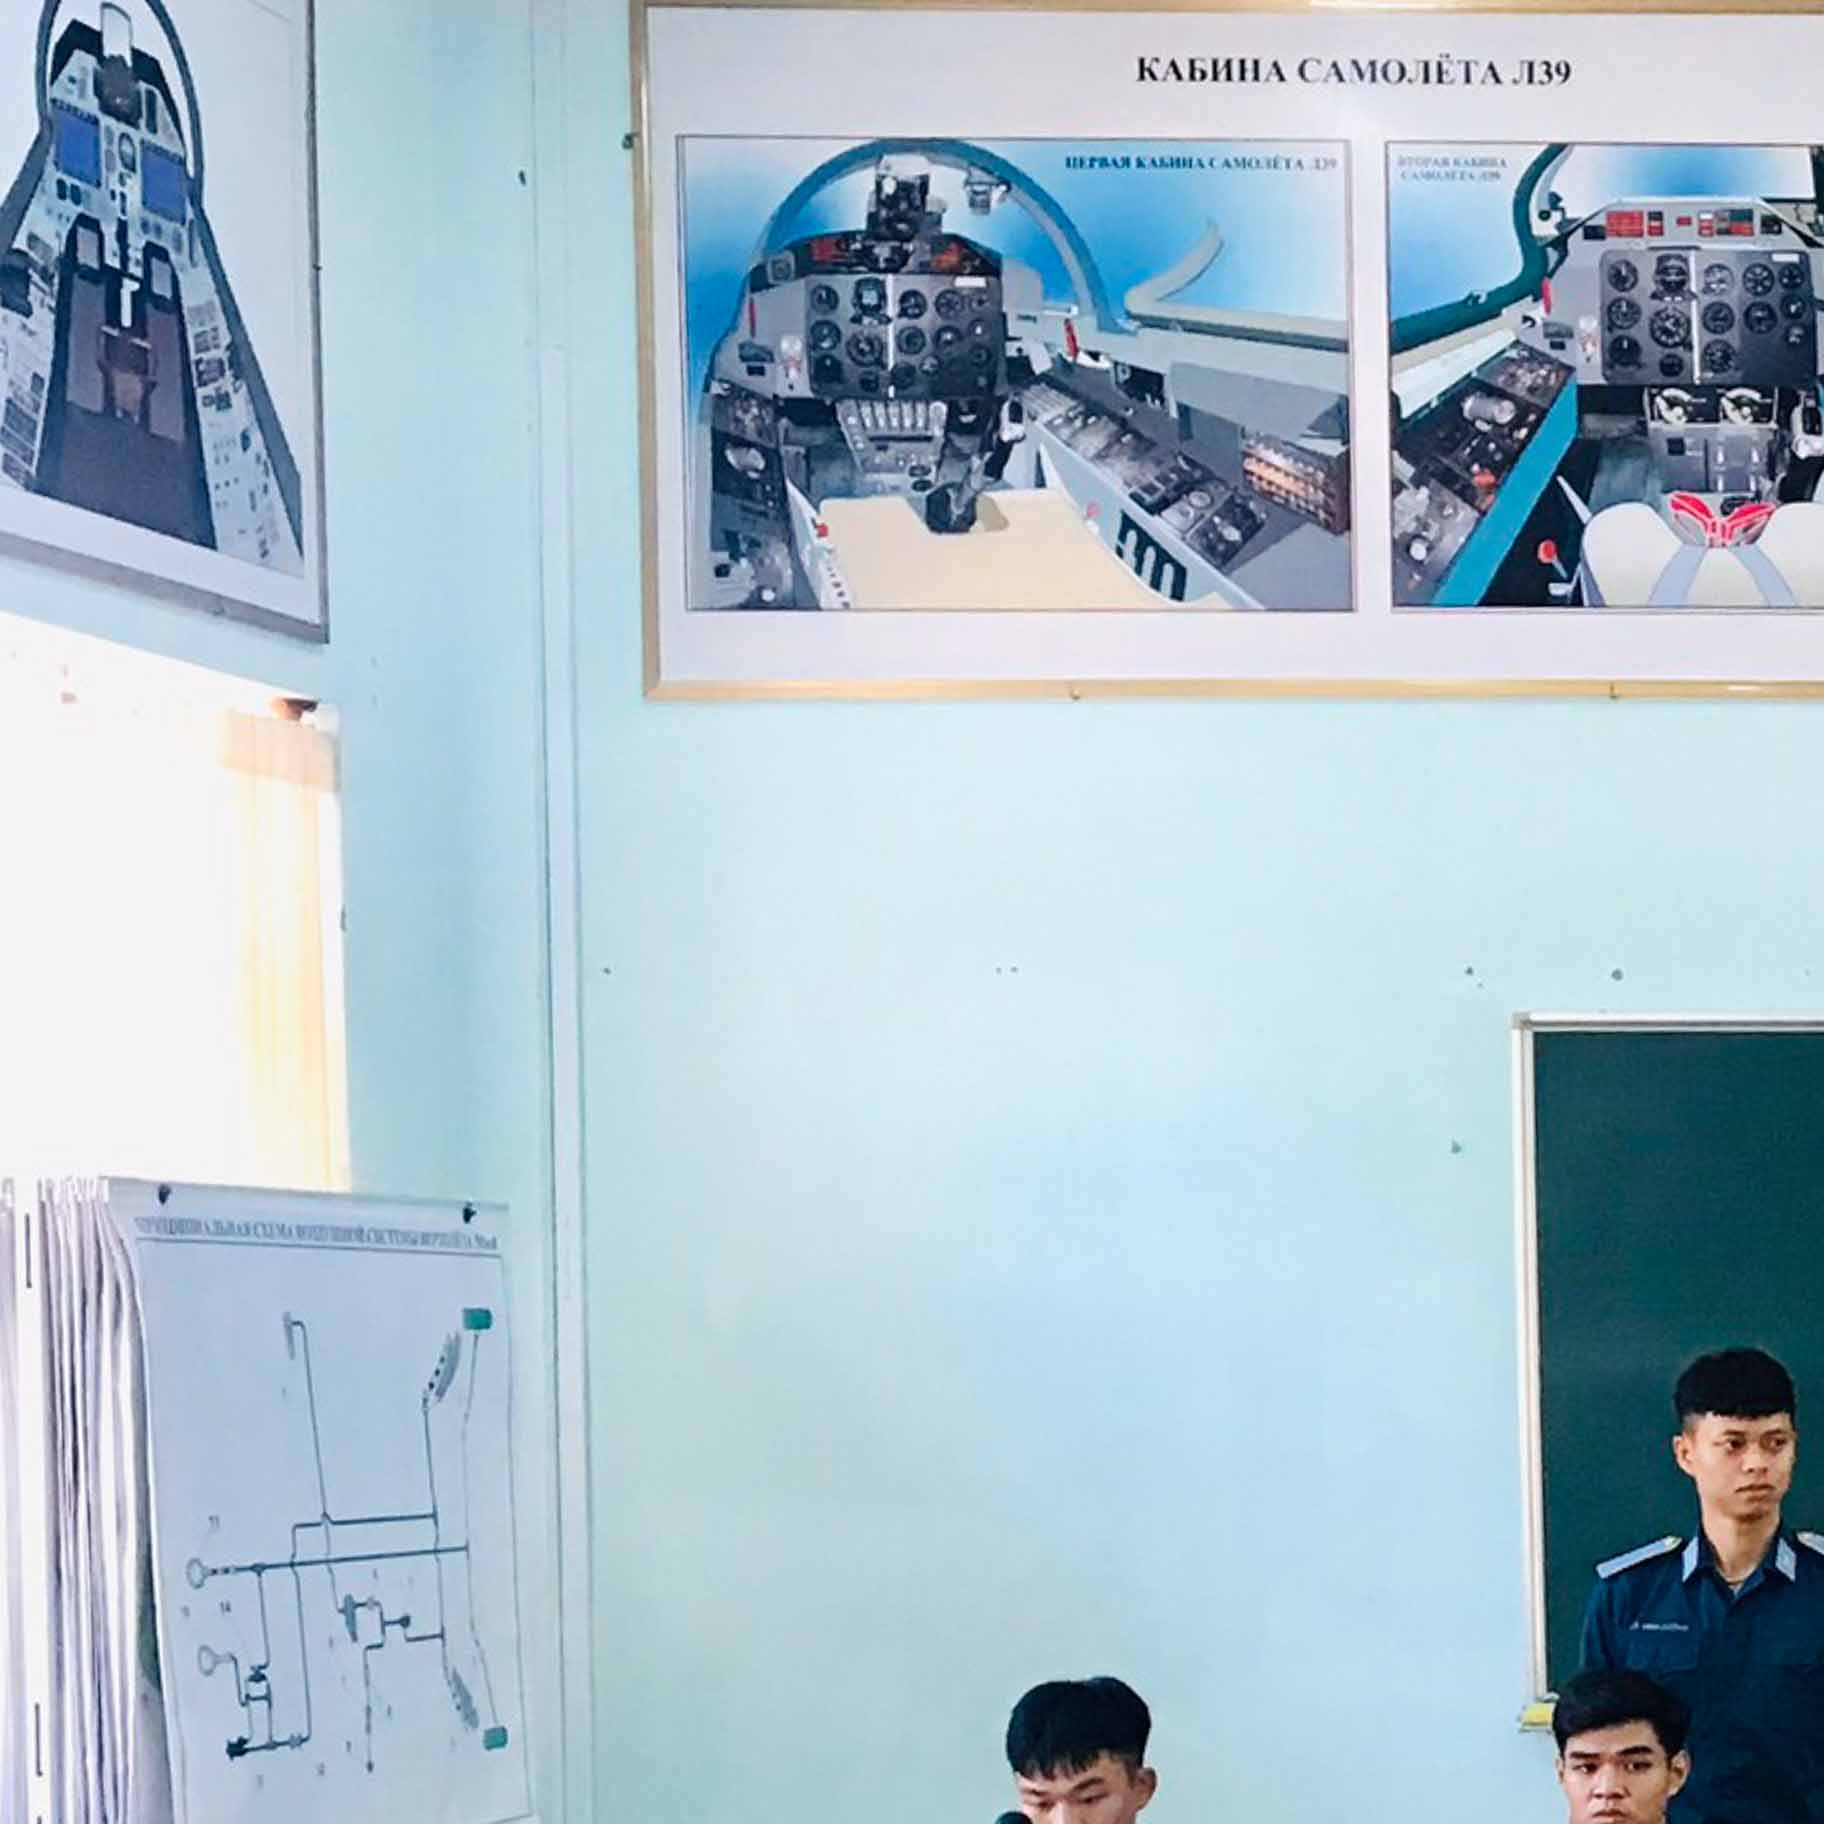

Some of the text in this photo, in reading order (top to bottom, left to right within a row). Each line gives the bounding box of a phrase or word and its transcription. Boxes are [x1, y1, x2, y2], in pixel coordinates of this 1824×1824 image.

[1136, 53, 1571, 86] КАБИНА САМОЛЁТА Л39
[1135, 155, 1205, 170] КАБИНА
